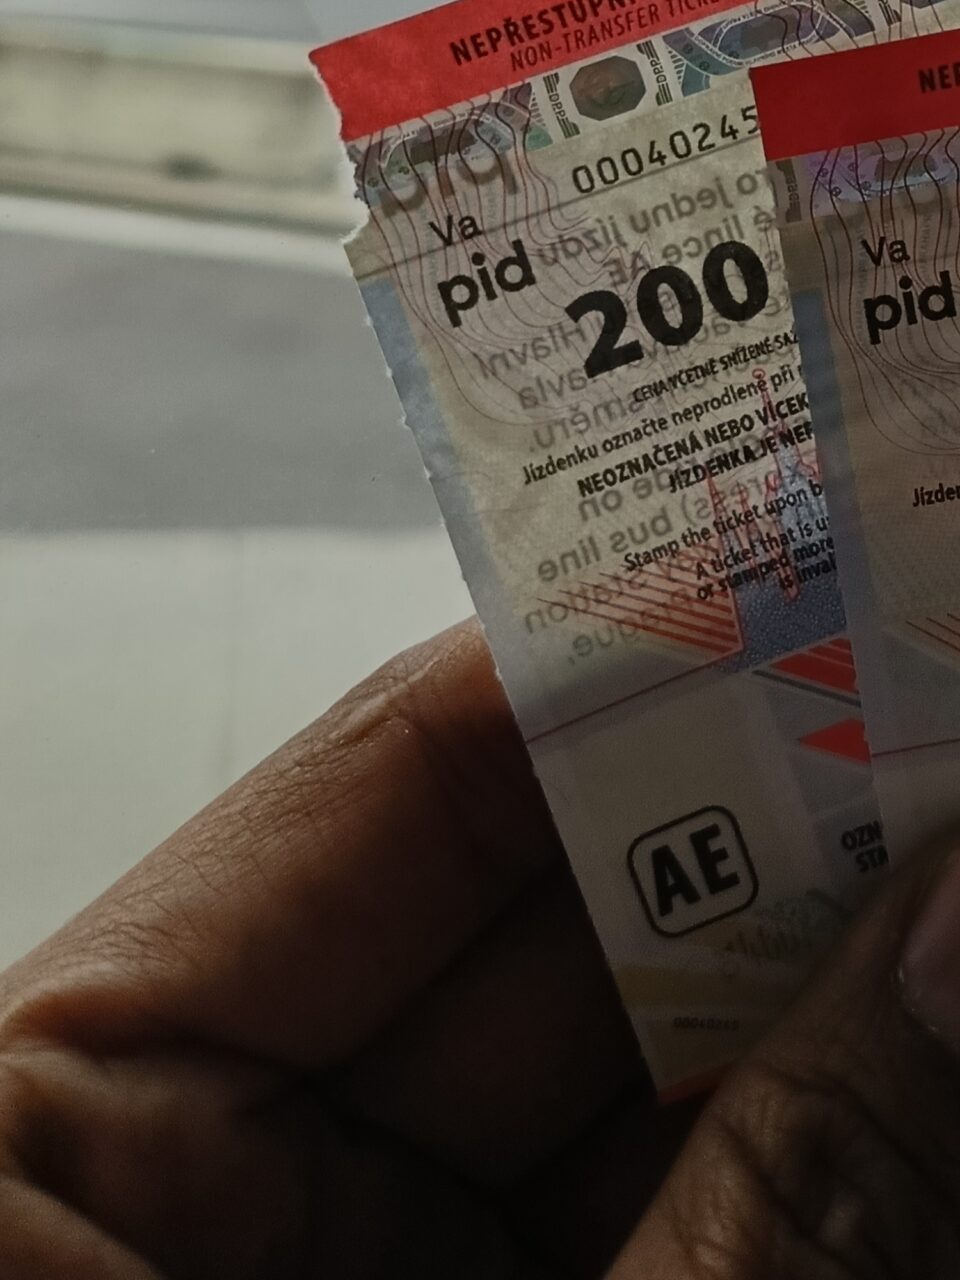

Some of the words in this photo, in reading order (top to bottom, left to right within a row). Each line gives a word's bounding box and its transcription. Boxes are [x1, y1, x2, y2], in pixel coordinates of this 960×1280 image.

[510, 4, 661, 72] NON-TRANSFER
[572, 105, 758, 194] 00040245
[429, 214, 483, 246] Va
[862, 235, 910, 267] Va
[437, 239, 536, 328] pid
[564, 241, 769, 378] 200
[863, 271, 958, 345] pid
[633, 380, 670, 404] CENA
[669, 360, 719, 391] VČETNĚ
[523, 444, 599, 485] Jízdenku
[602, 419, 669, 454] označte
[671, 379, 767, 426] neprodleně
[770, 365, 796, 394] při
[577, 431, 703, 498] NEOZNAČENÁ
[704, 413, 751, 448] NEBO
[669, 444, 755, 494] JÍZDENKA
[754, 432, 780, 459] JE
[624, 540, 681, 572] Stamp
[681, 526, 711, 549] the
[715, 503, 764, 537] ticket
[766, 486, 806, 517] upon
[697, 561, 709, 581] A
[711, 543, 759, 573] ticket
[761, 528, 797, 553] that
[799, 521, 813, 539] is
[697, 584, 714, 600] or
[718, 549, 789, 593] stamped
[651, 824, 740, 917] AE
